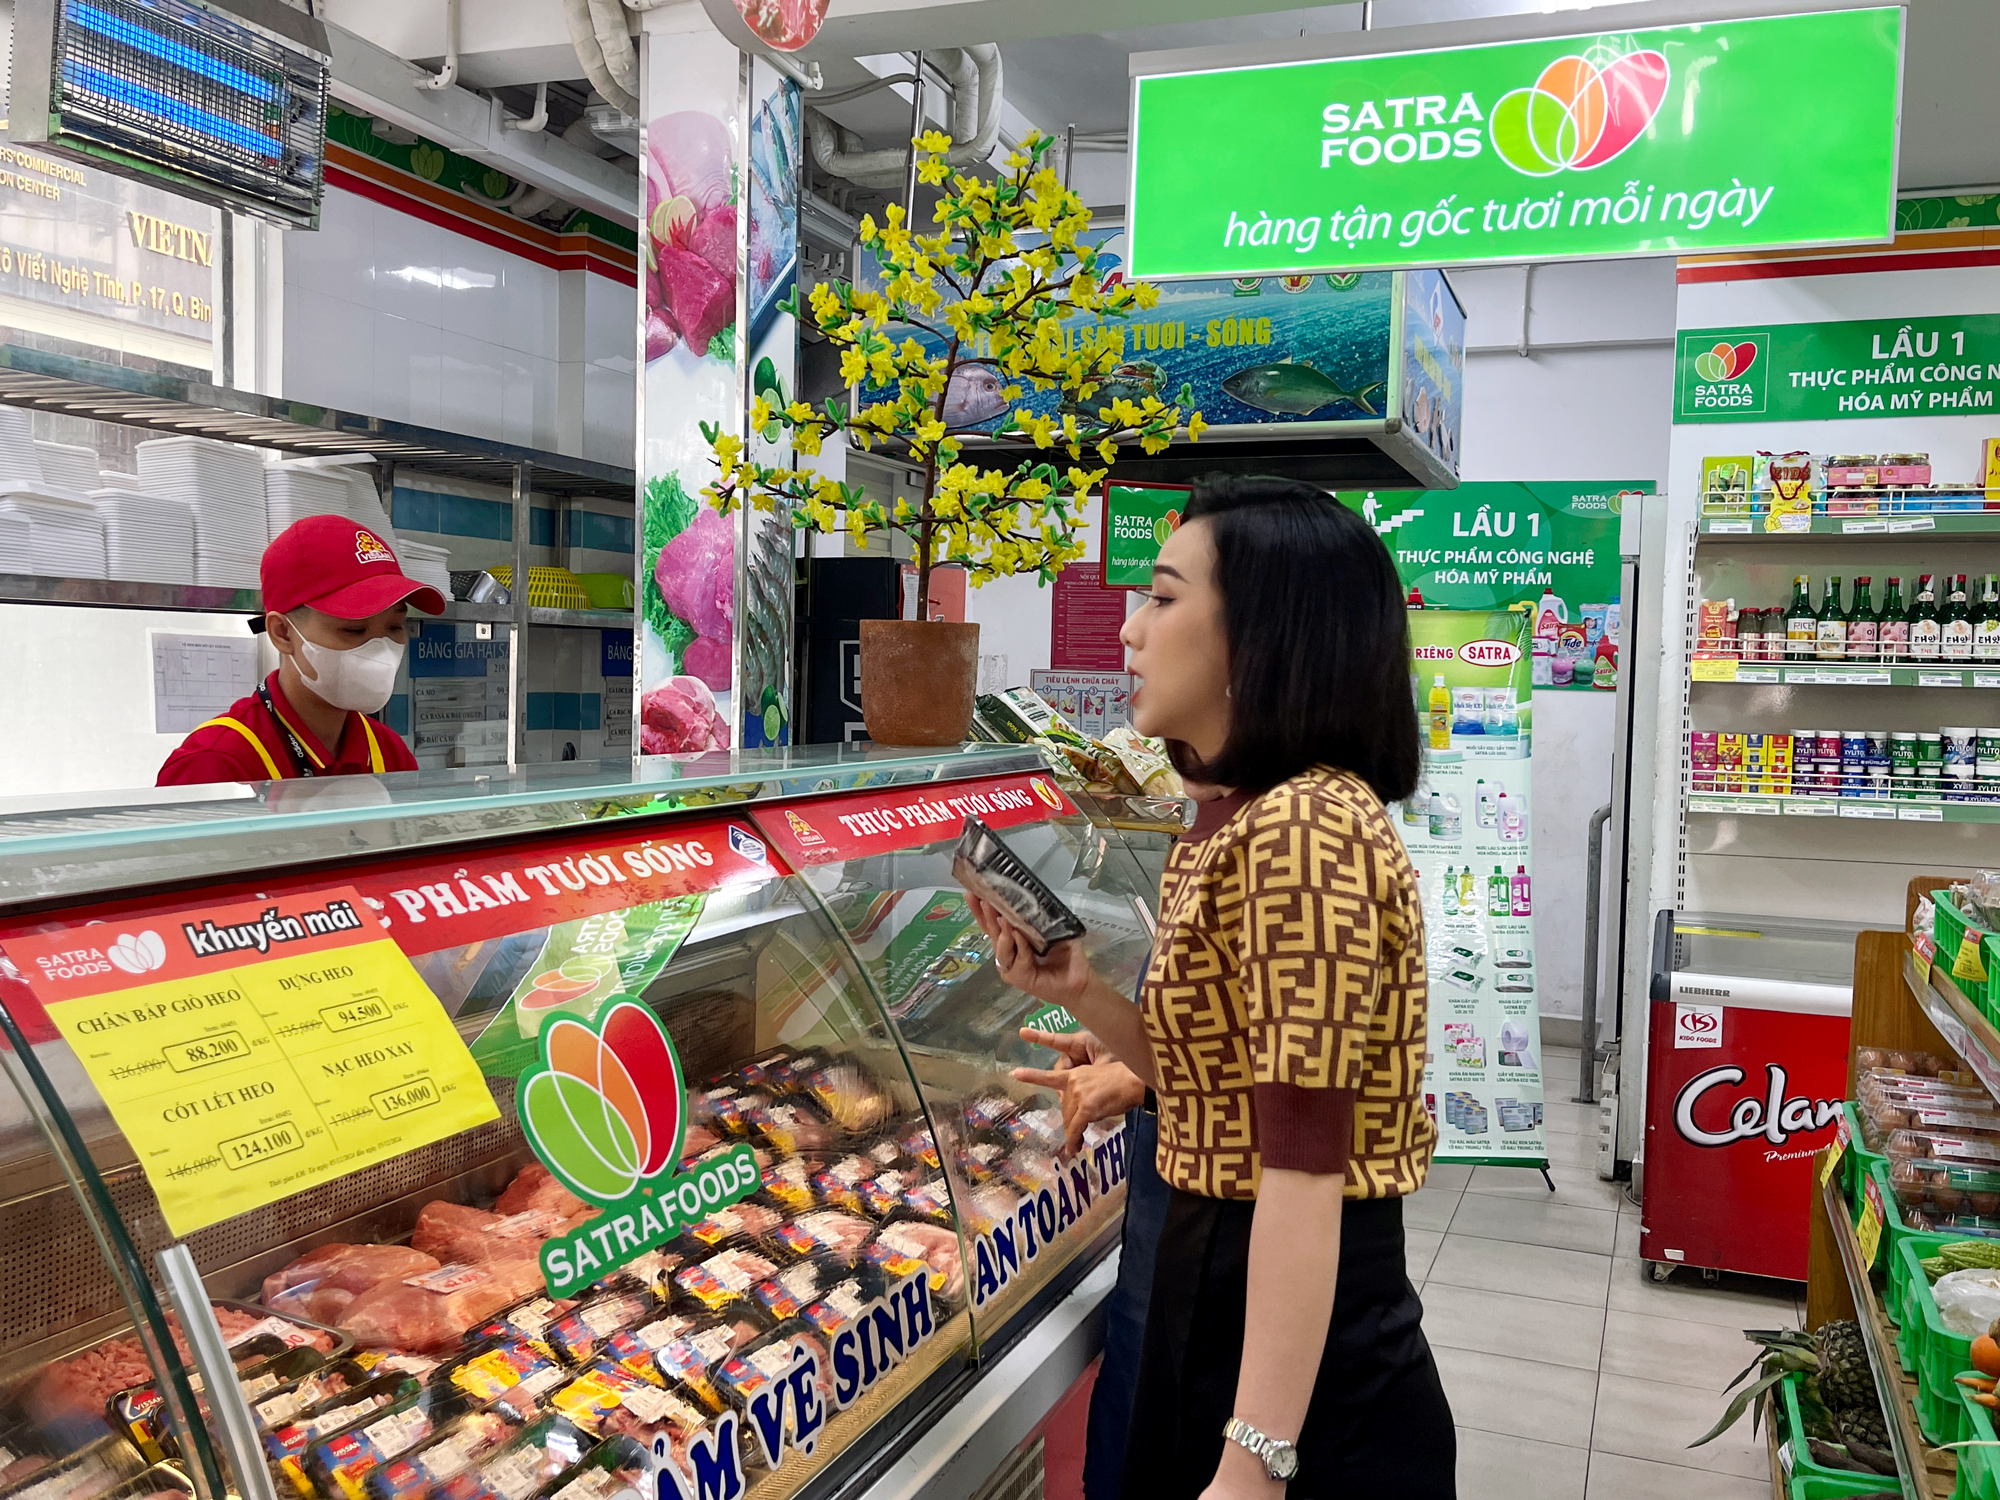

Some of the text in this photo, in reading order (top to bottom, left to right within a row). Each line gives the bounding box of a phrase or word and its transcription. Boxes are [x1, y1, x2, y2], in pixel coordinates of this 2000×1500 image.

[1321, 91, 1485, 134] SATRA
[1320, 127, 1482, 168] FOODS
[17, 175, 60, 201] CENTER
[1223, 178, 1775, 253] hàng tận gốc tươi mỗi ngày
[128, 210, 212, 268] VIETN
[0, 246, 12, 274] ô
[17, 251, 46, 282] Viết
[51, 261, 89, 297] Nghệ
[93, 271, 128, 306] Tĩnh,
[131, 281, 147, 305] P.
[150, 286, 169, 315] 17,
[172, 291, 187, 317] Q.
[1131, 319, 1185, 350] TƯƠI
[1206, 313, 1271, 348] SỐNG
[1872, 325, 1965, 360] LẦU 1
[1789, 368, 1846, 391] THỰC
[1851, 362, 1915, 386] PHẨM
[1920, 362, 1981, 383] CÔNG
[1695, 383, 1754, 397] SATRA
[1838, 385, 1993, 412] HÓA MỸ PHẨM
[1694, 395, 1753, 408] FOODS
[1572, 494, 1607, 503] SATRA
[1572, 502, 1607, 510] FOODS
[1114, 515, 1153, 527] SATRA
[1452, 504, 1540, 538] LẦU 1
[1114, 527, 1152, 539] FOODS
[361, 551, 392, 561] VISSAN
[1112, 555, 1151, 568] hàng tận gốc
[1397, 546, 1595, 568] THỰC PHẨM CÔNG NGHỆ
[1434, 567, 1552, 586] HÓA MỸ PHẨM
[1540, 621, 1560, 631] Satra
[419, 638, 451, 659] BẢNG
[607, 641, 632, 661] BẢNG
[1415, 645, 1511, 660] RIÊNG SATRA
[1562, 637, 1582, 648] Tide
[1045, 674, 1120, 686] TIÊU LỆNH CHỮA CHÁY
[1595, 667, 1612, 675] Satra
[839, 786, 1033, 837] THỰC PHẨM TƯƠI SỐNG
[799, 833, 822, 843] VISSAN
[389, 840, 713, 923] PHẨM TƯƠI SỐNG
[184, 902, 361, 956] khuyến mãi
[36, 948, 105, 969] SATRA
[44, 960, 113, 981] FOODS
[278, 965, 354, 990] DỰNG HEO
[1679, 985, 1731, 997] LIEBHERR
[77, 988, 241, 1035] CHÂN BẮP GIÒ HEO
[338, 1003, 383, 1024] 94,500
[1696, 1036, 1717, 1044] FOODS
[109, 1059, 164, 1080] 126,000
[185, 1038, 239, 1063] 88,200
[321, 1041, 416, 1078] NẠC HEO XAY
[162, 1081, 275, 1123] CỐT LẾT HEO
[330, 1105, 372, 1127] 170,000
[381, 1084, 431, 1112] 136,000
[166, 1155, 219, 1181] 146,000
[232, 1129, 292, 1162] 124,100
[1764, 1149, 1818, 1163] Premium
[974, 1129, 1126, 1306] AN TOÀN TH
[751, 1346, 822, 1467] VỆ
[833, 1273, 934, 1407] SINH
